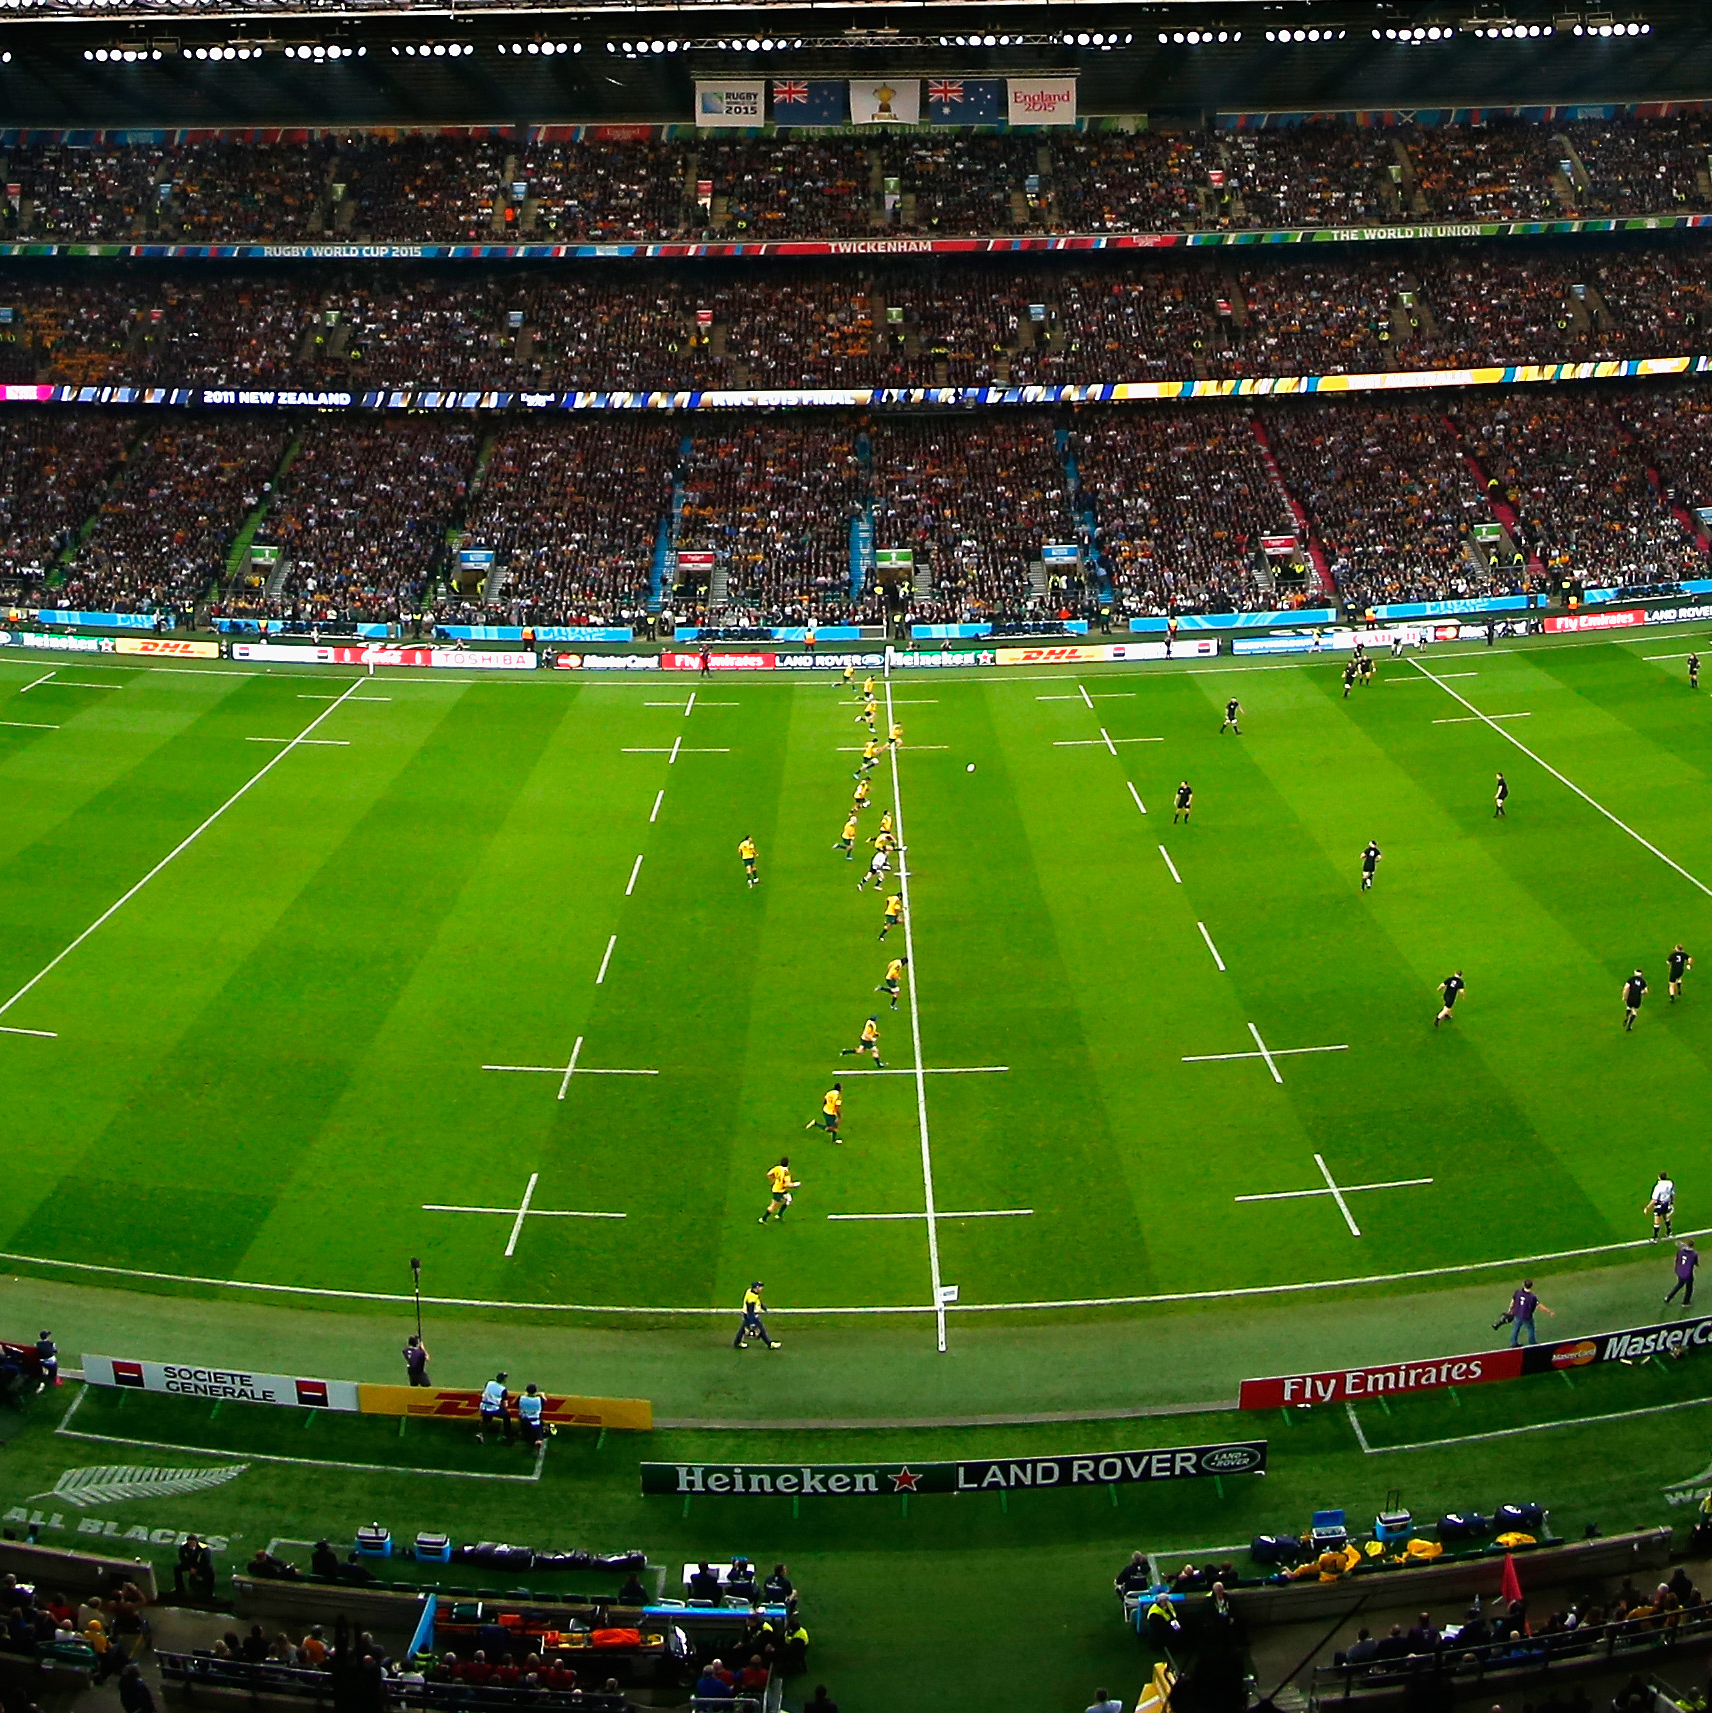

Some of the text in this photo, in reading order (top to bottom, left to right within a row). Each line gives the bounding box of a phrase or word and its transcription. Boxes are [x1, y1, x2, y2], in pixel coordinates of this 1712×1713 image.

[725, 92, 758, 101] RUGBY
[1014, 90, 1070, 104] England
[725, 106, 757, 114] 2015
[1025, 101, 1056, 112] 2015
[1331, 226, 1481, 241] THE WORLD IN UNION
[264, 247, 422, 257] RUGBY WORLD CUP 2015
[828, 241, 932, 254] TWICKENHAM
[203, 390, 351, 406] 2011 NEW ZEALAND
[802, 392, 855, 405] FINAL
[1556, 612, 1635, 630] Fly Emirates
[1644, 610, 1676, 623] LAND
[23, 633, 99, 650] Heineken
[139, 641, 196, 655] DHL
[443, 653, 526, 665] TOSHIBA
[675, 654, 700, 669] Fly
[775, 655, 863, 666] LAND ROVER
[890, 651, 976, 666] Heineken
[1022, 648, 1083, 661] DHL
[164, 1366, 253, 1387] SOCIETE
[1283, 1360, 1482, 1403] Fly Emirates
[165, 1380, 276, 1403] GENERALE
[958, 1452, 1197, 1488] LAND ROVER
[675, 1466, 880, 1493] Heineken
[1, 1506, 65, 1528] ALL
